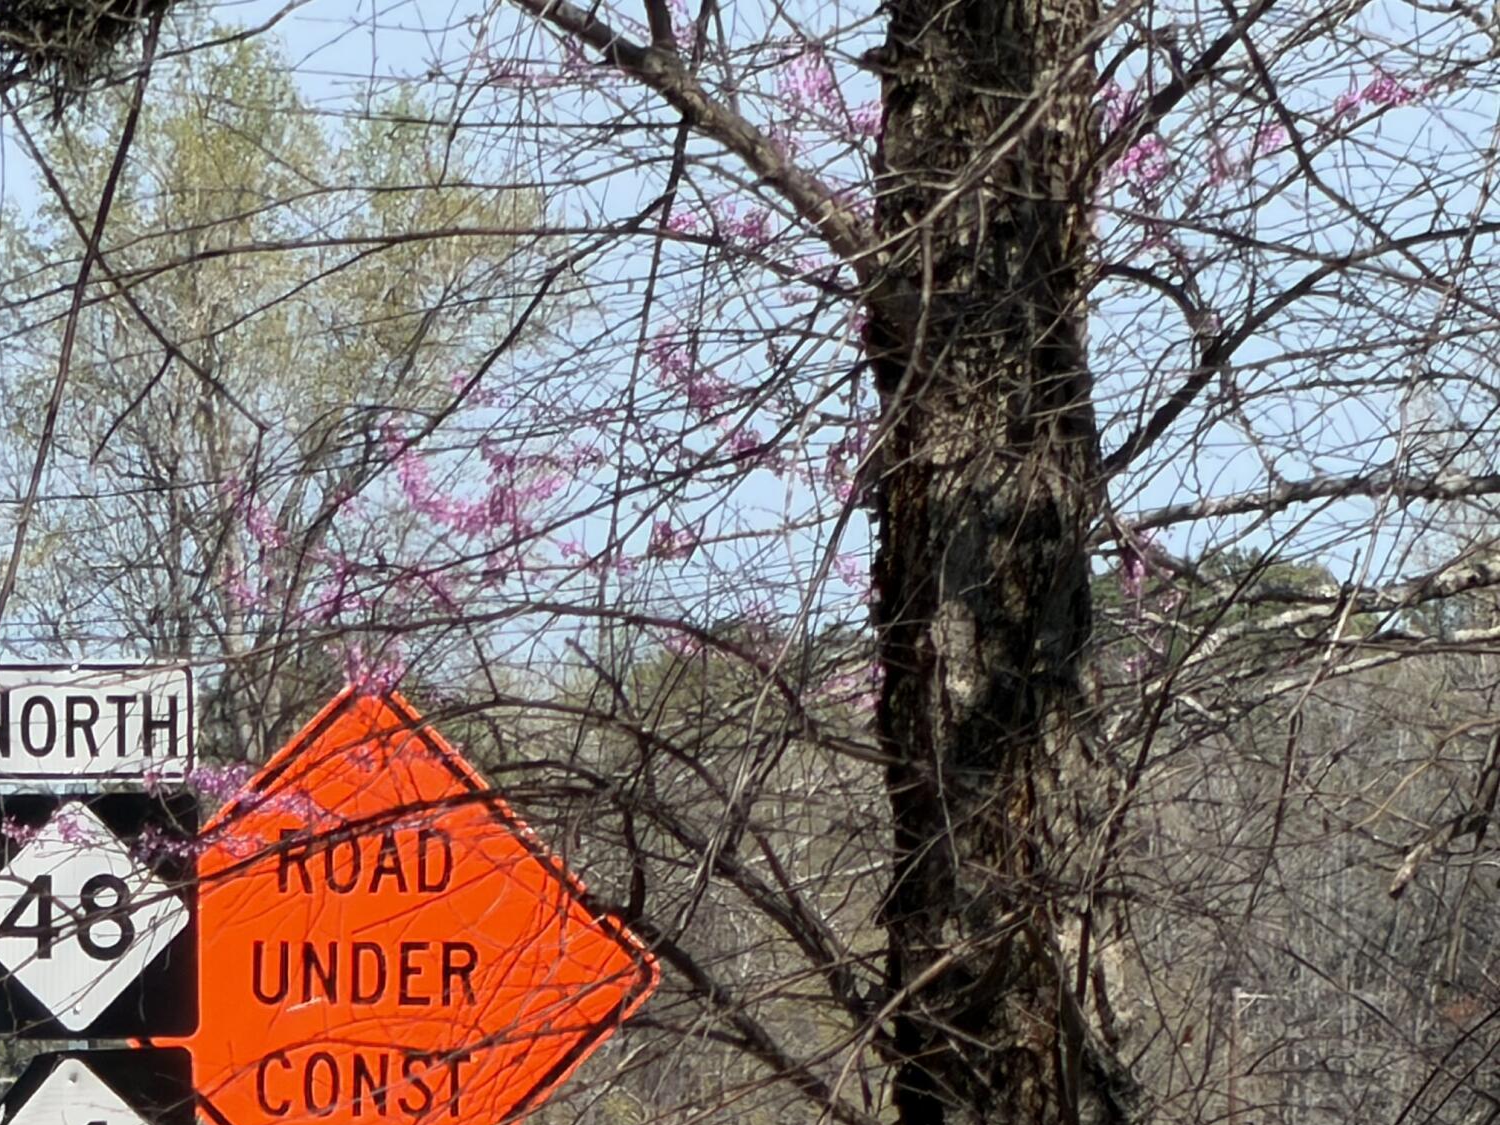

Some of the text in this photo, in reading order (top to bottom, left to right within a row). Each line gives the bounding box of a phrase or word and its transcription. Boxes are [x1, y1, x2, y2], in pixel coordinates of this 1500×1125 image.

[277, 828, 452, 894] ROAD
[0, 873, 134, 961] 48
[252, 940, 478, 1006] UNDER
[256, 1051, 472, 1118] CONST
